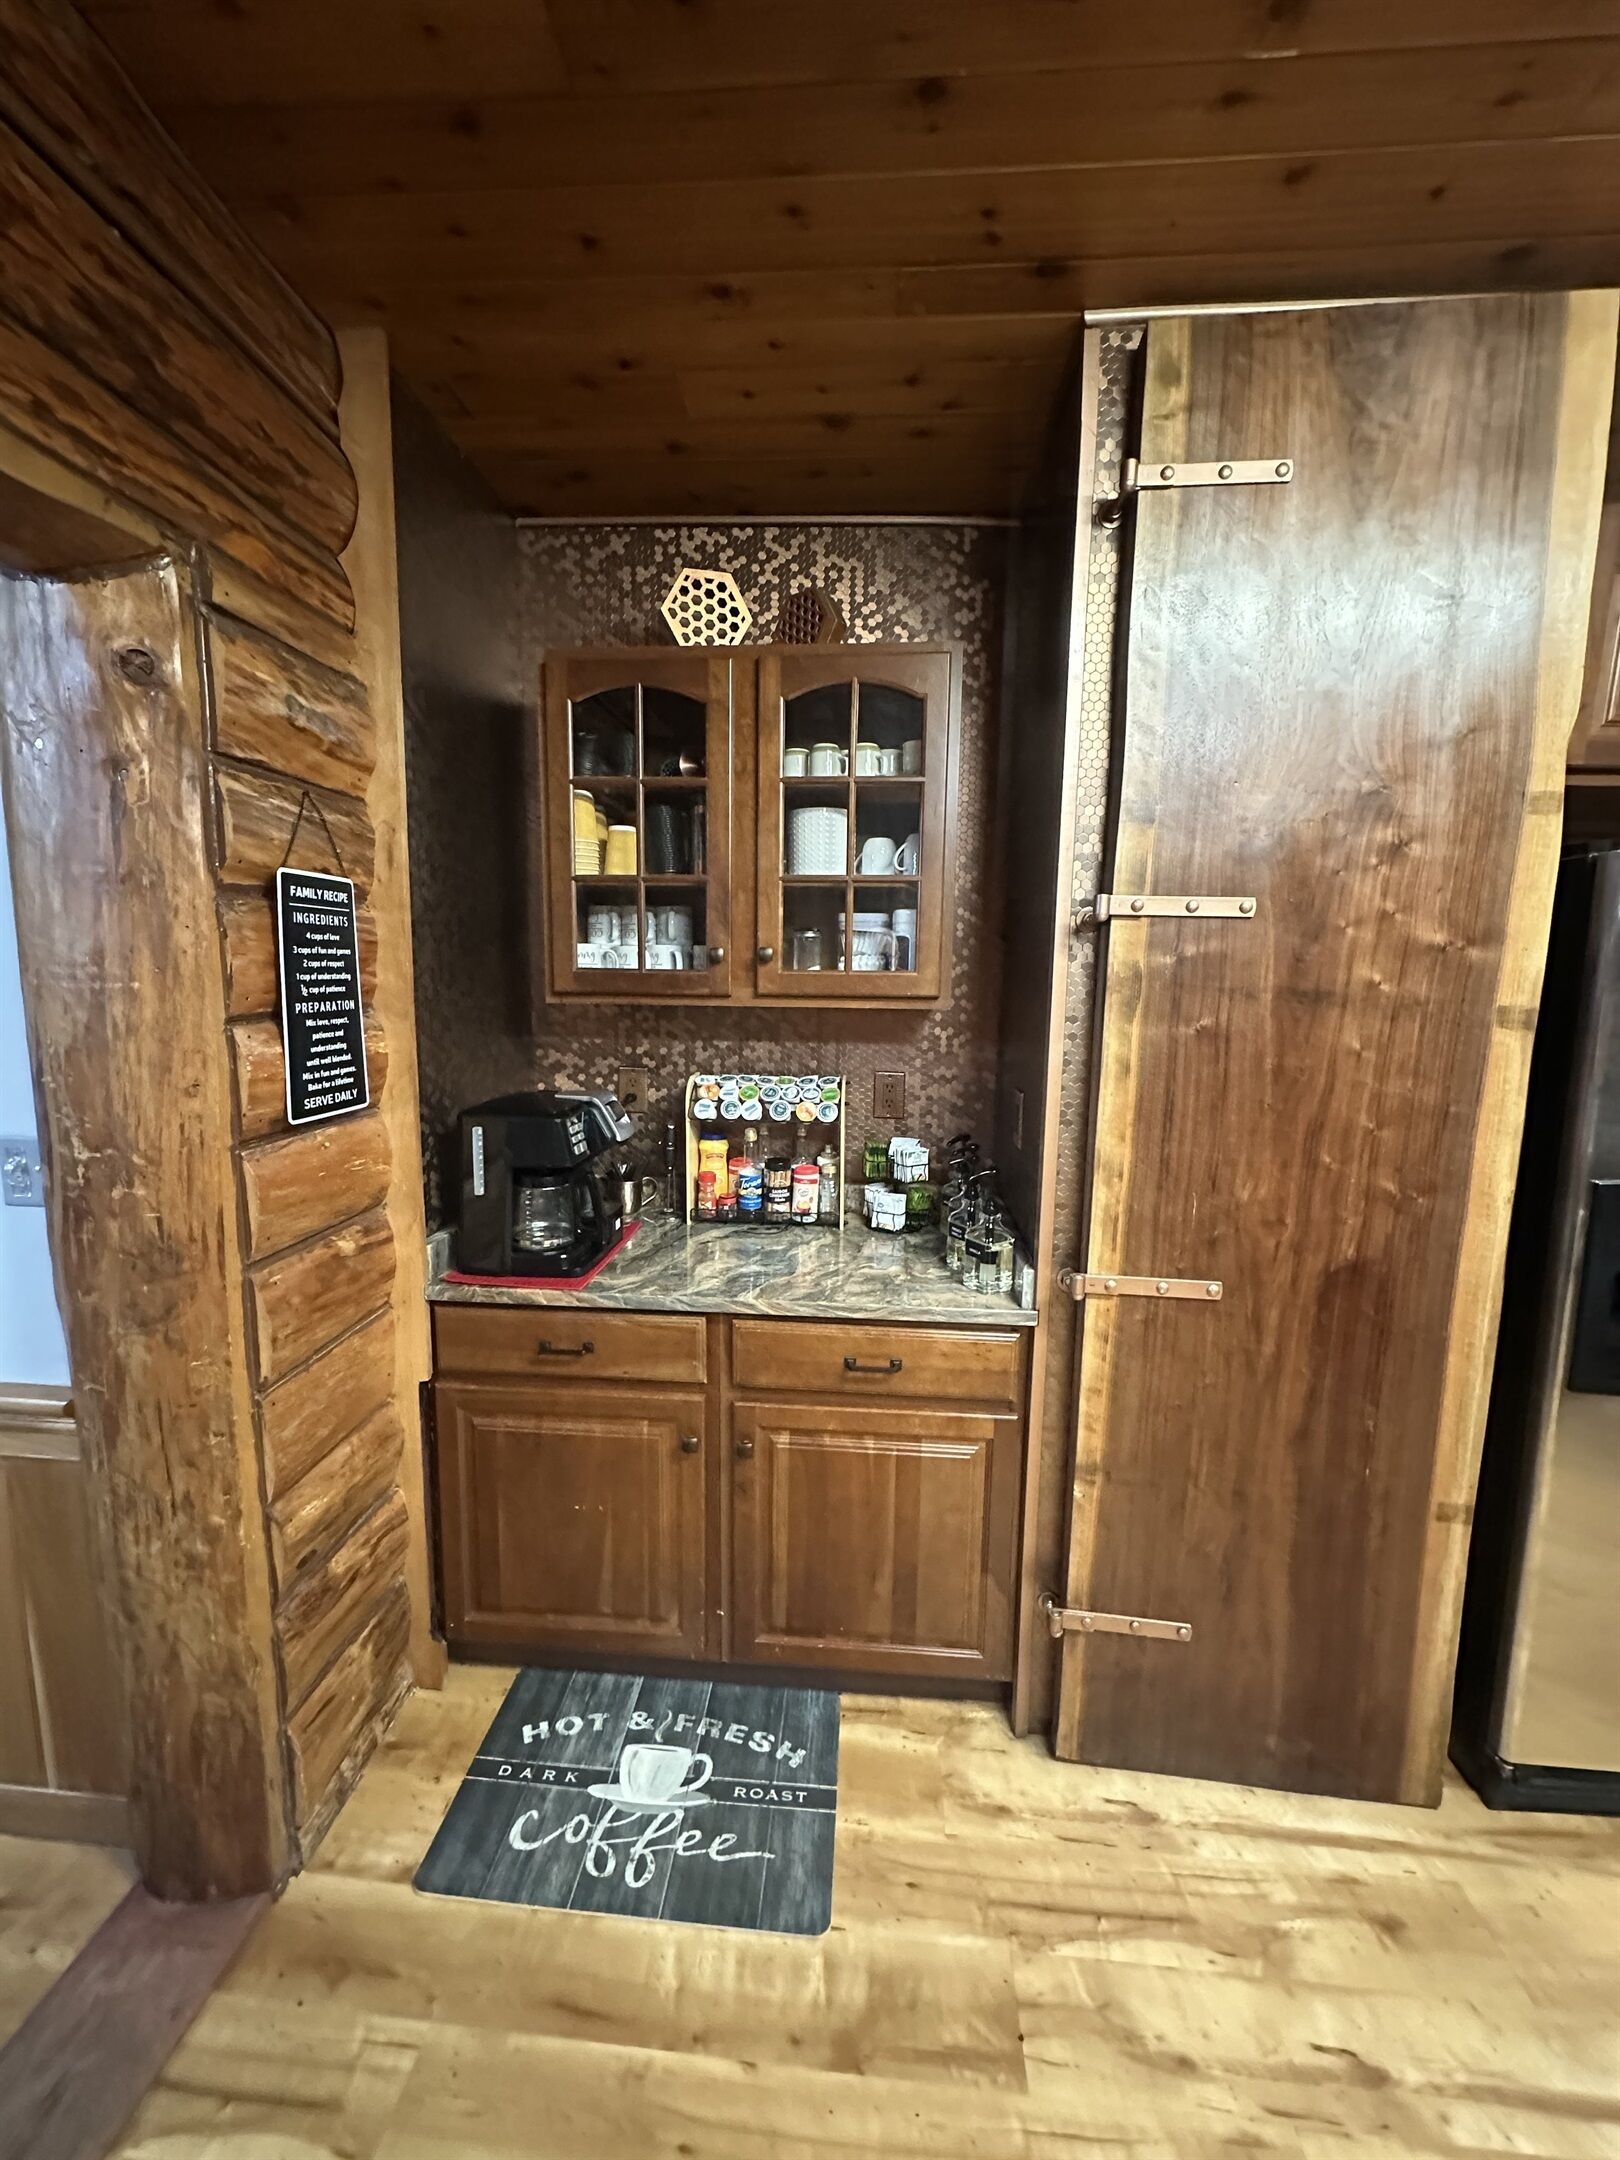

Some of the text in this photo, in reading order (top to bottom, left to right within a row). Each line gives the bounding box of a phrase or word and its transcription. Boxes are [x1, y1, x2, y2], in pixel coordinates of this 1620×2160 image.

[290, 885, 348, 903] FAMILY RECIPE
[293, 912, 348, 927] INGREDIENTS
[311, 933, 323, 941] cups
[293, 946, 297, 954] 3
[298, 947, 311, 955] cups
[312, 946, 318, 954] of
[318, 972, 351, 981] understanding
[320, 985, 326, 993] of
[326, 985, 346, 994] patience
[295, 1000, 355, 1014] PREPARATION
[306, 1019, 316, 1027] Mix
[312, 1029, 344, 1041] patience and
[310, 1042, 347, 1053] understanding
[303, 1072, 313, 1080] Mix
[330, 1067, 340, 1075] and
[308, 1083, 322, 1091] Bake
[304, 1088, 358, 1109] SERVE DAILY
[522, 1711, 806, 1768] HOT & FRESH
[498, 1765, 808, 1802] DARK ROAST
